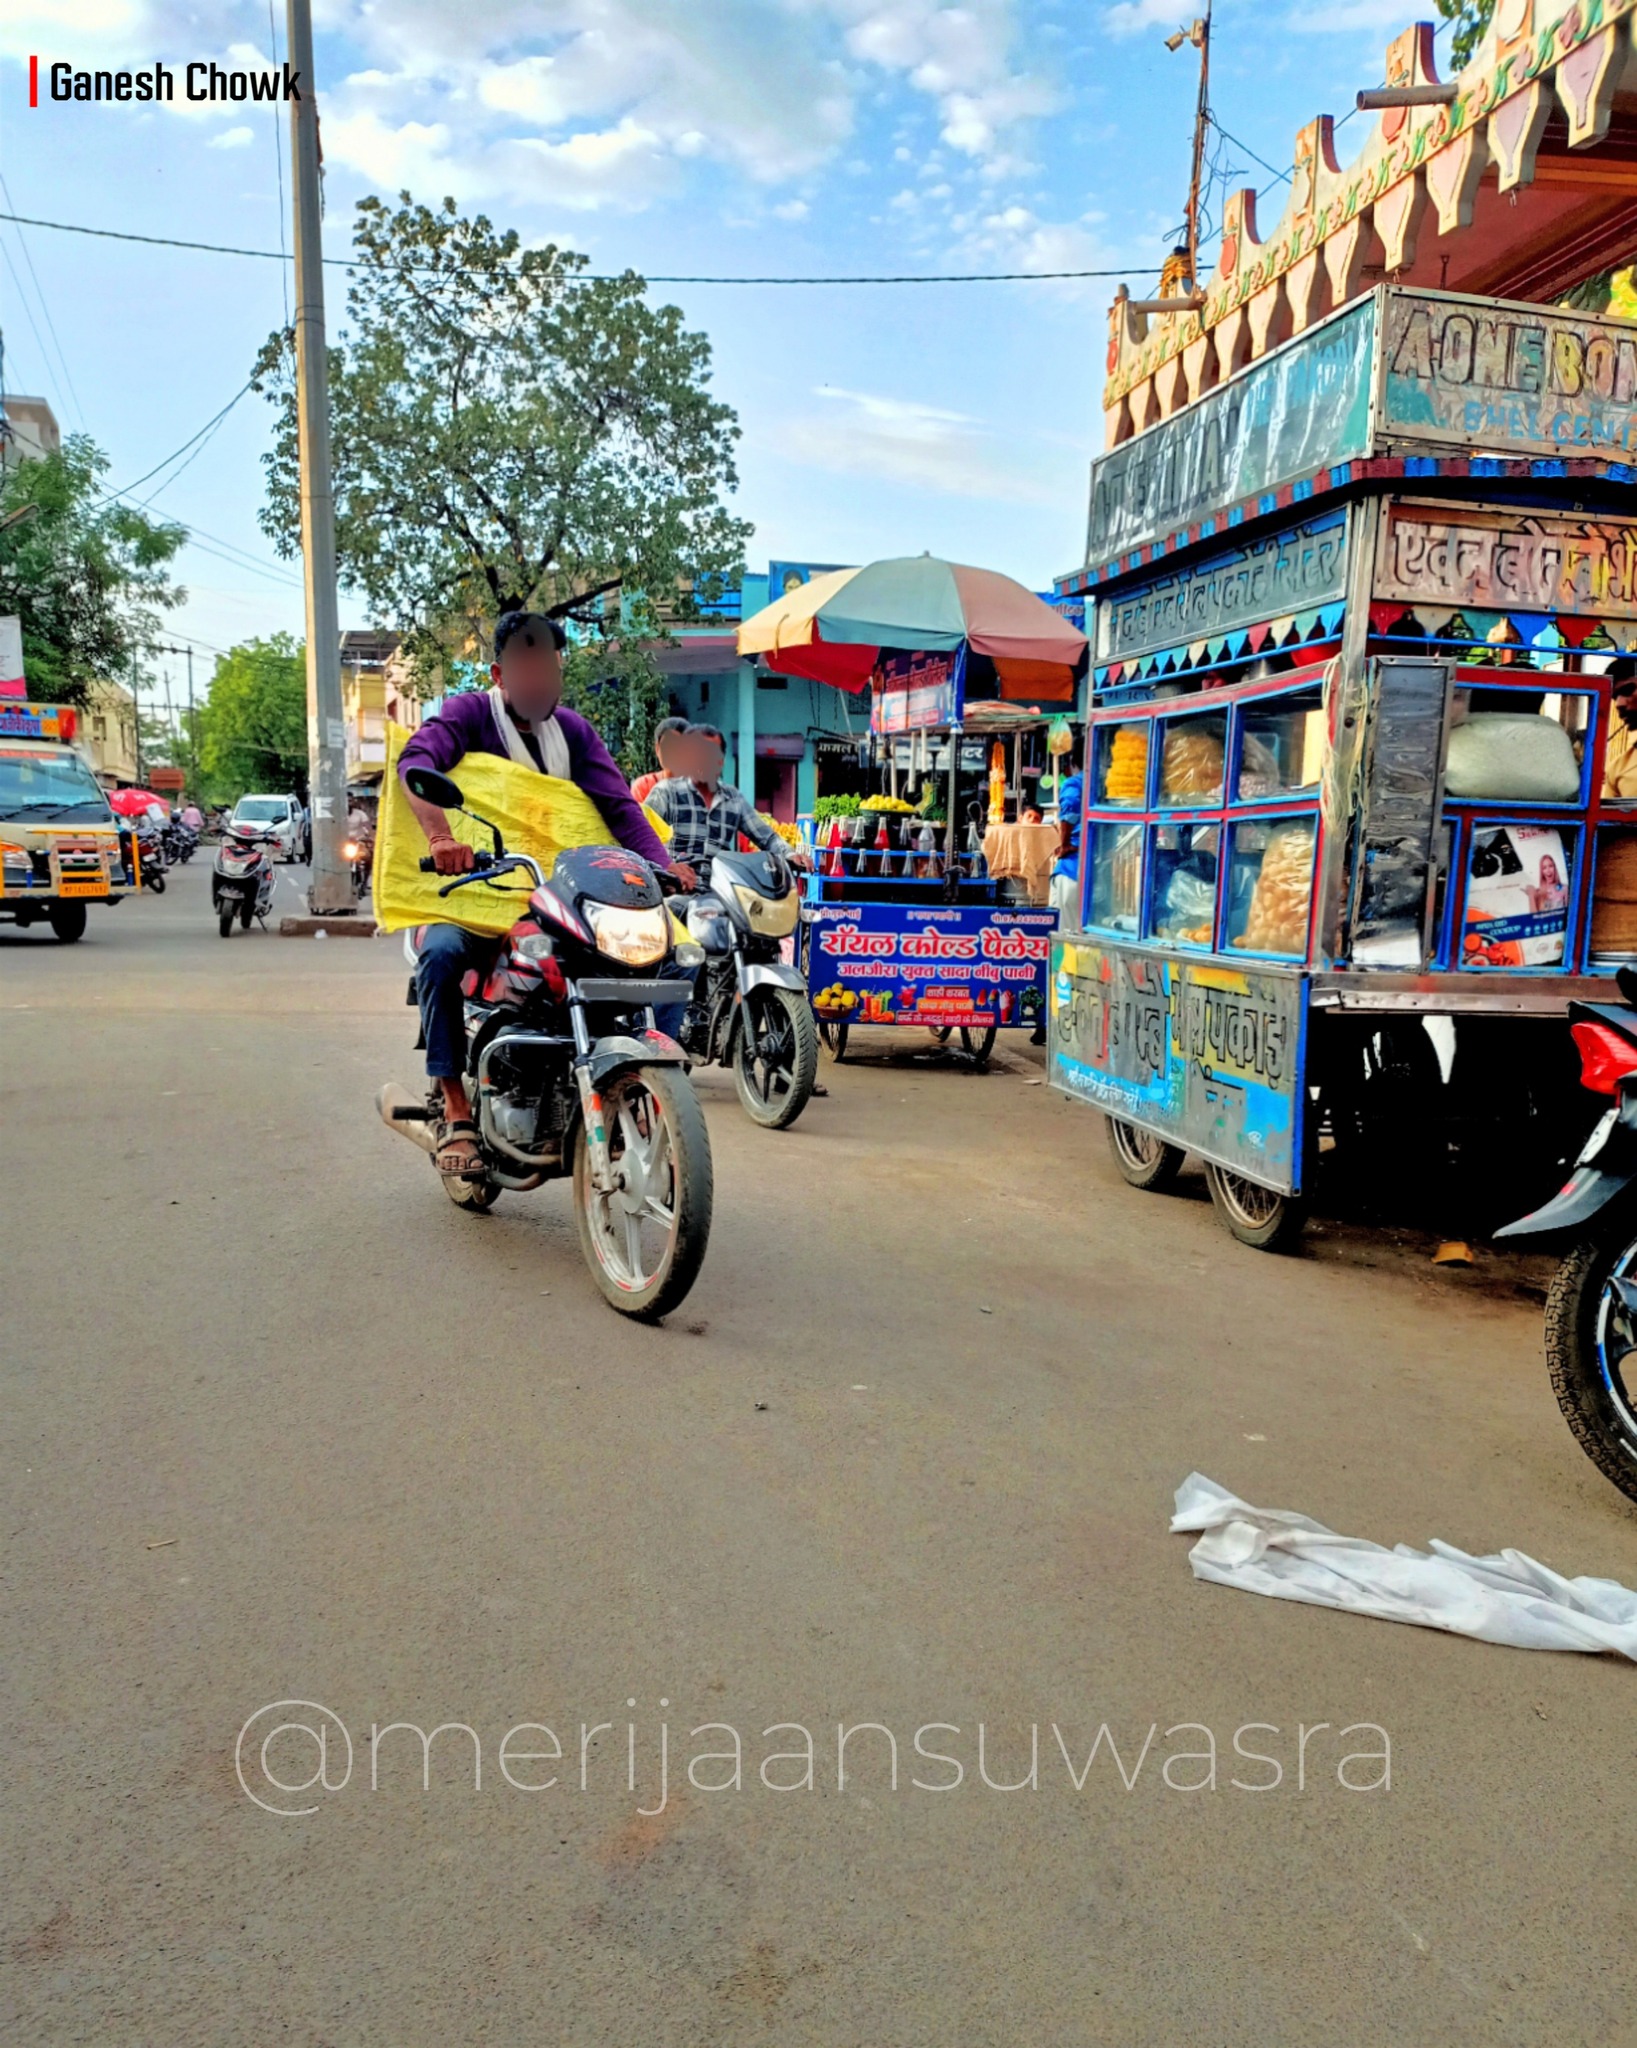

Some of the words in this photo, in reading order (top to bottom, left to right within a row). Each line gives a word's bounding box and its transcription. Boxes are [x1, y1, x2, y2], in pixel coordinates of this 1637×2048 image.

[1464, 400, 1544, 441] BHEL
[820, 924, 897, 957] रॉयल
[899, 926, 979, 959] कोल्ड
[980, 927, 1050, 960] पैलेस
[837, 960, 897, 978] जलजीरा
[901, 964, 935, 980] युक्त
[937, 964, 971, 979] सादा
[1003, 962, 1037, 980] पानी
